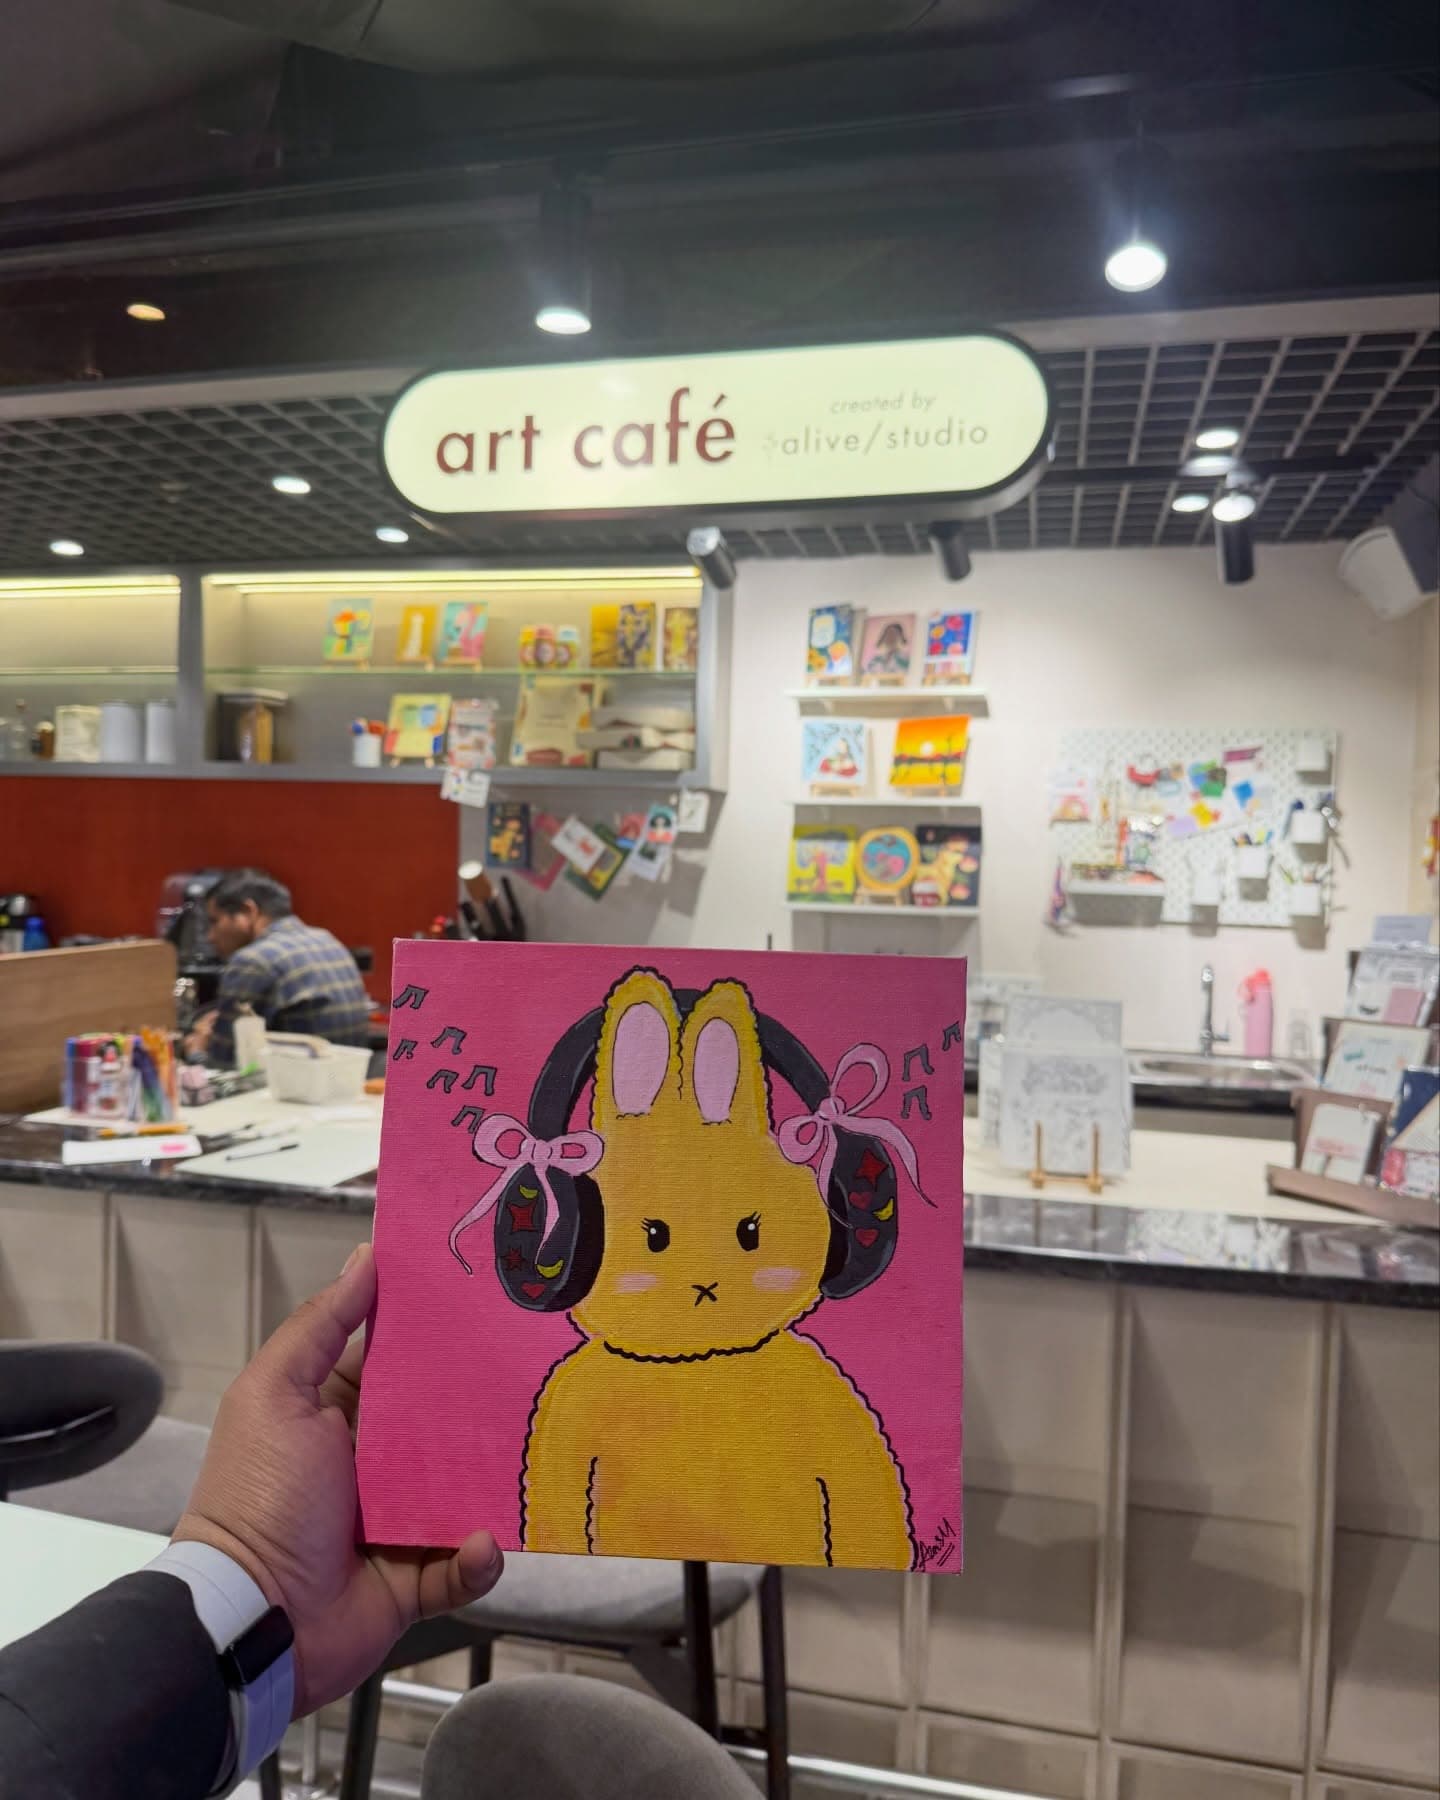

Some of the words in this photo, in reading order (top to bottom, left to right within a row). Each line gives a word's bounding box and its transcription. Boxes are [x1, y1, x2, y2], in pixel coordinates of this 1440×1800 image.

[829, 393, 904, 415] created
[911, 389, 938, 412] by
[436, 415, 541, 475] art
[573, 386, 736, 470] café
[781, 416, 989, 456] alive/studio
